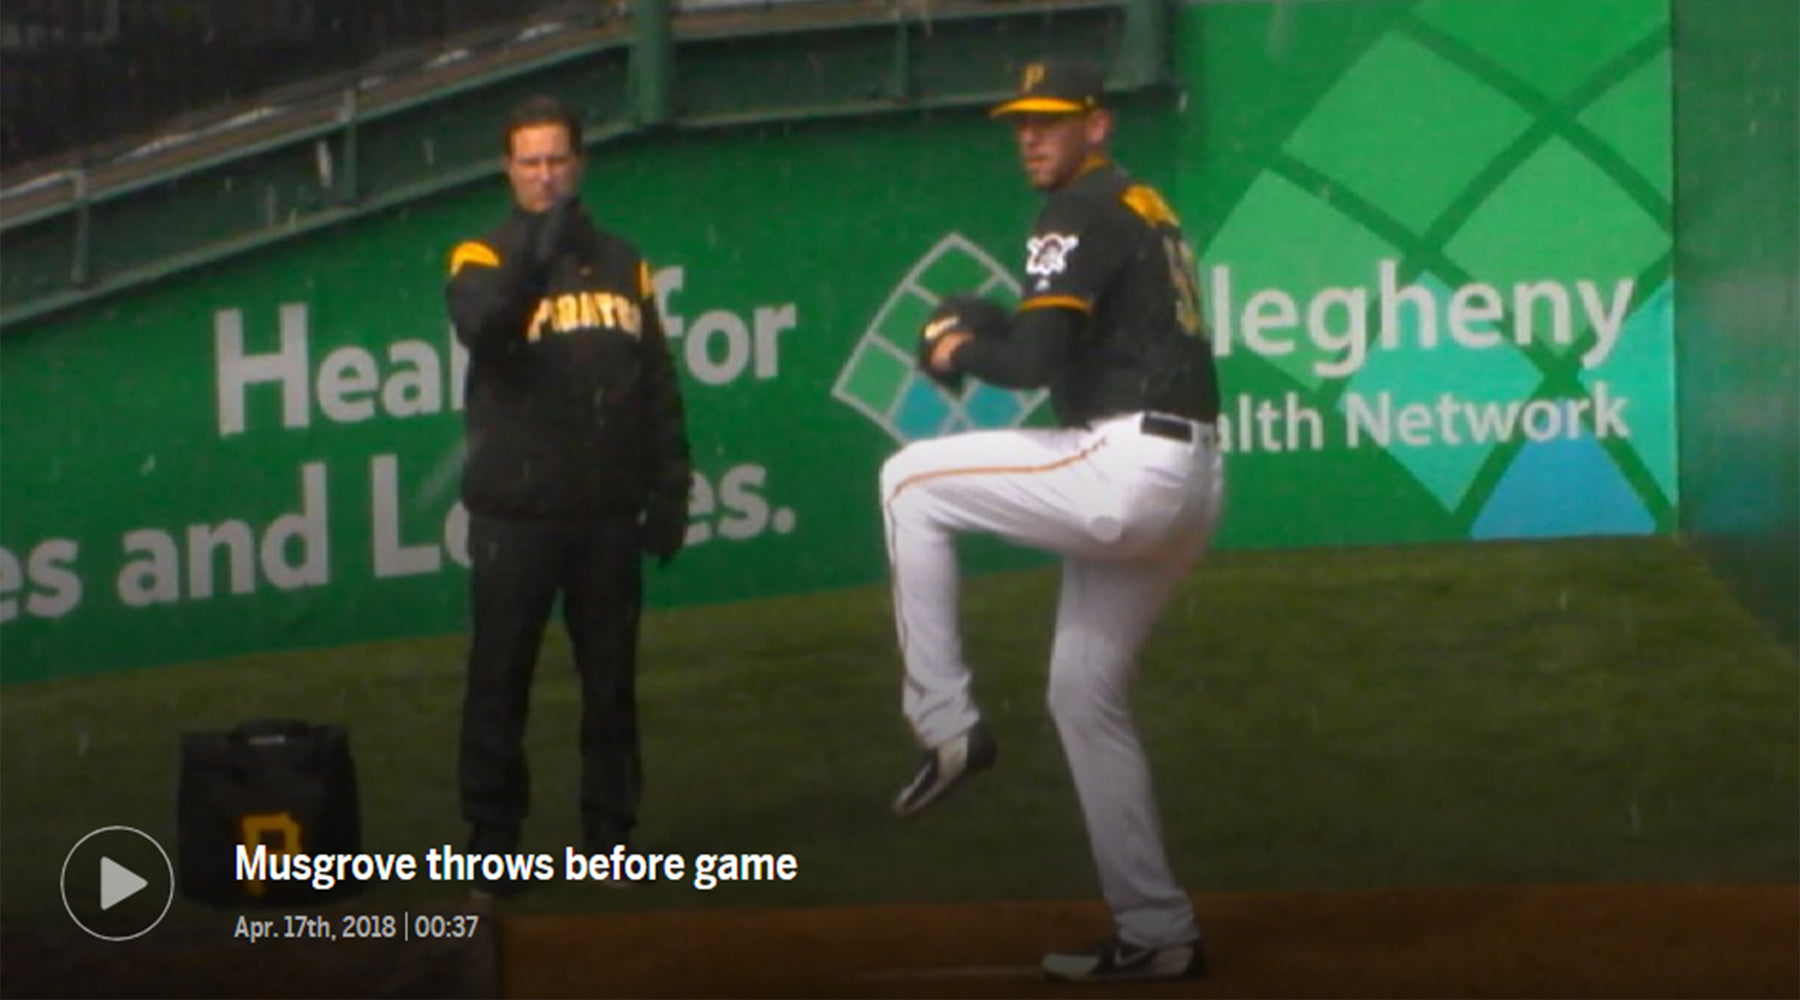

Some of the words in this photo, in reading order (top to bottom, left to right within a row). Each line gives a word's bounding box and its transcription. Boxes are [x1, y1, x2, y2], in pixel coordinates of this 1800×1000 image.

[652, 266, 797, 385] for
[1211, 259, 1634, 377] legheny
[1345, 380, 1631, 450] Network
[117, 461, 331, 607] and
